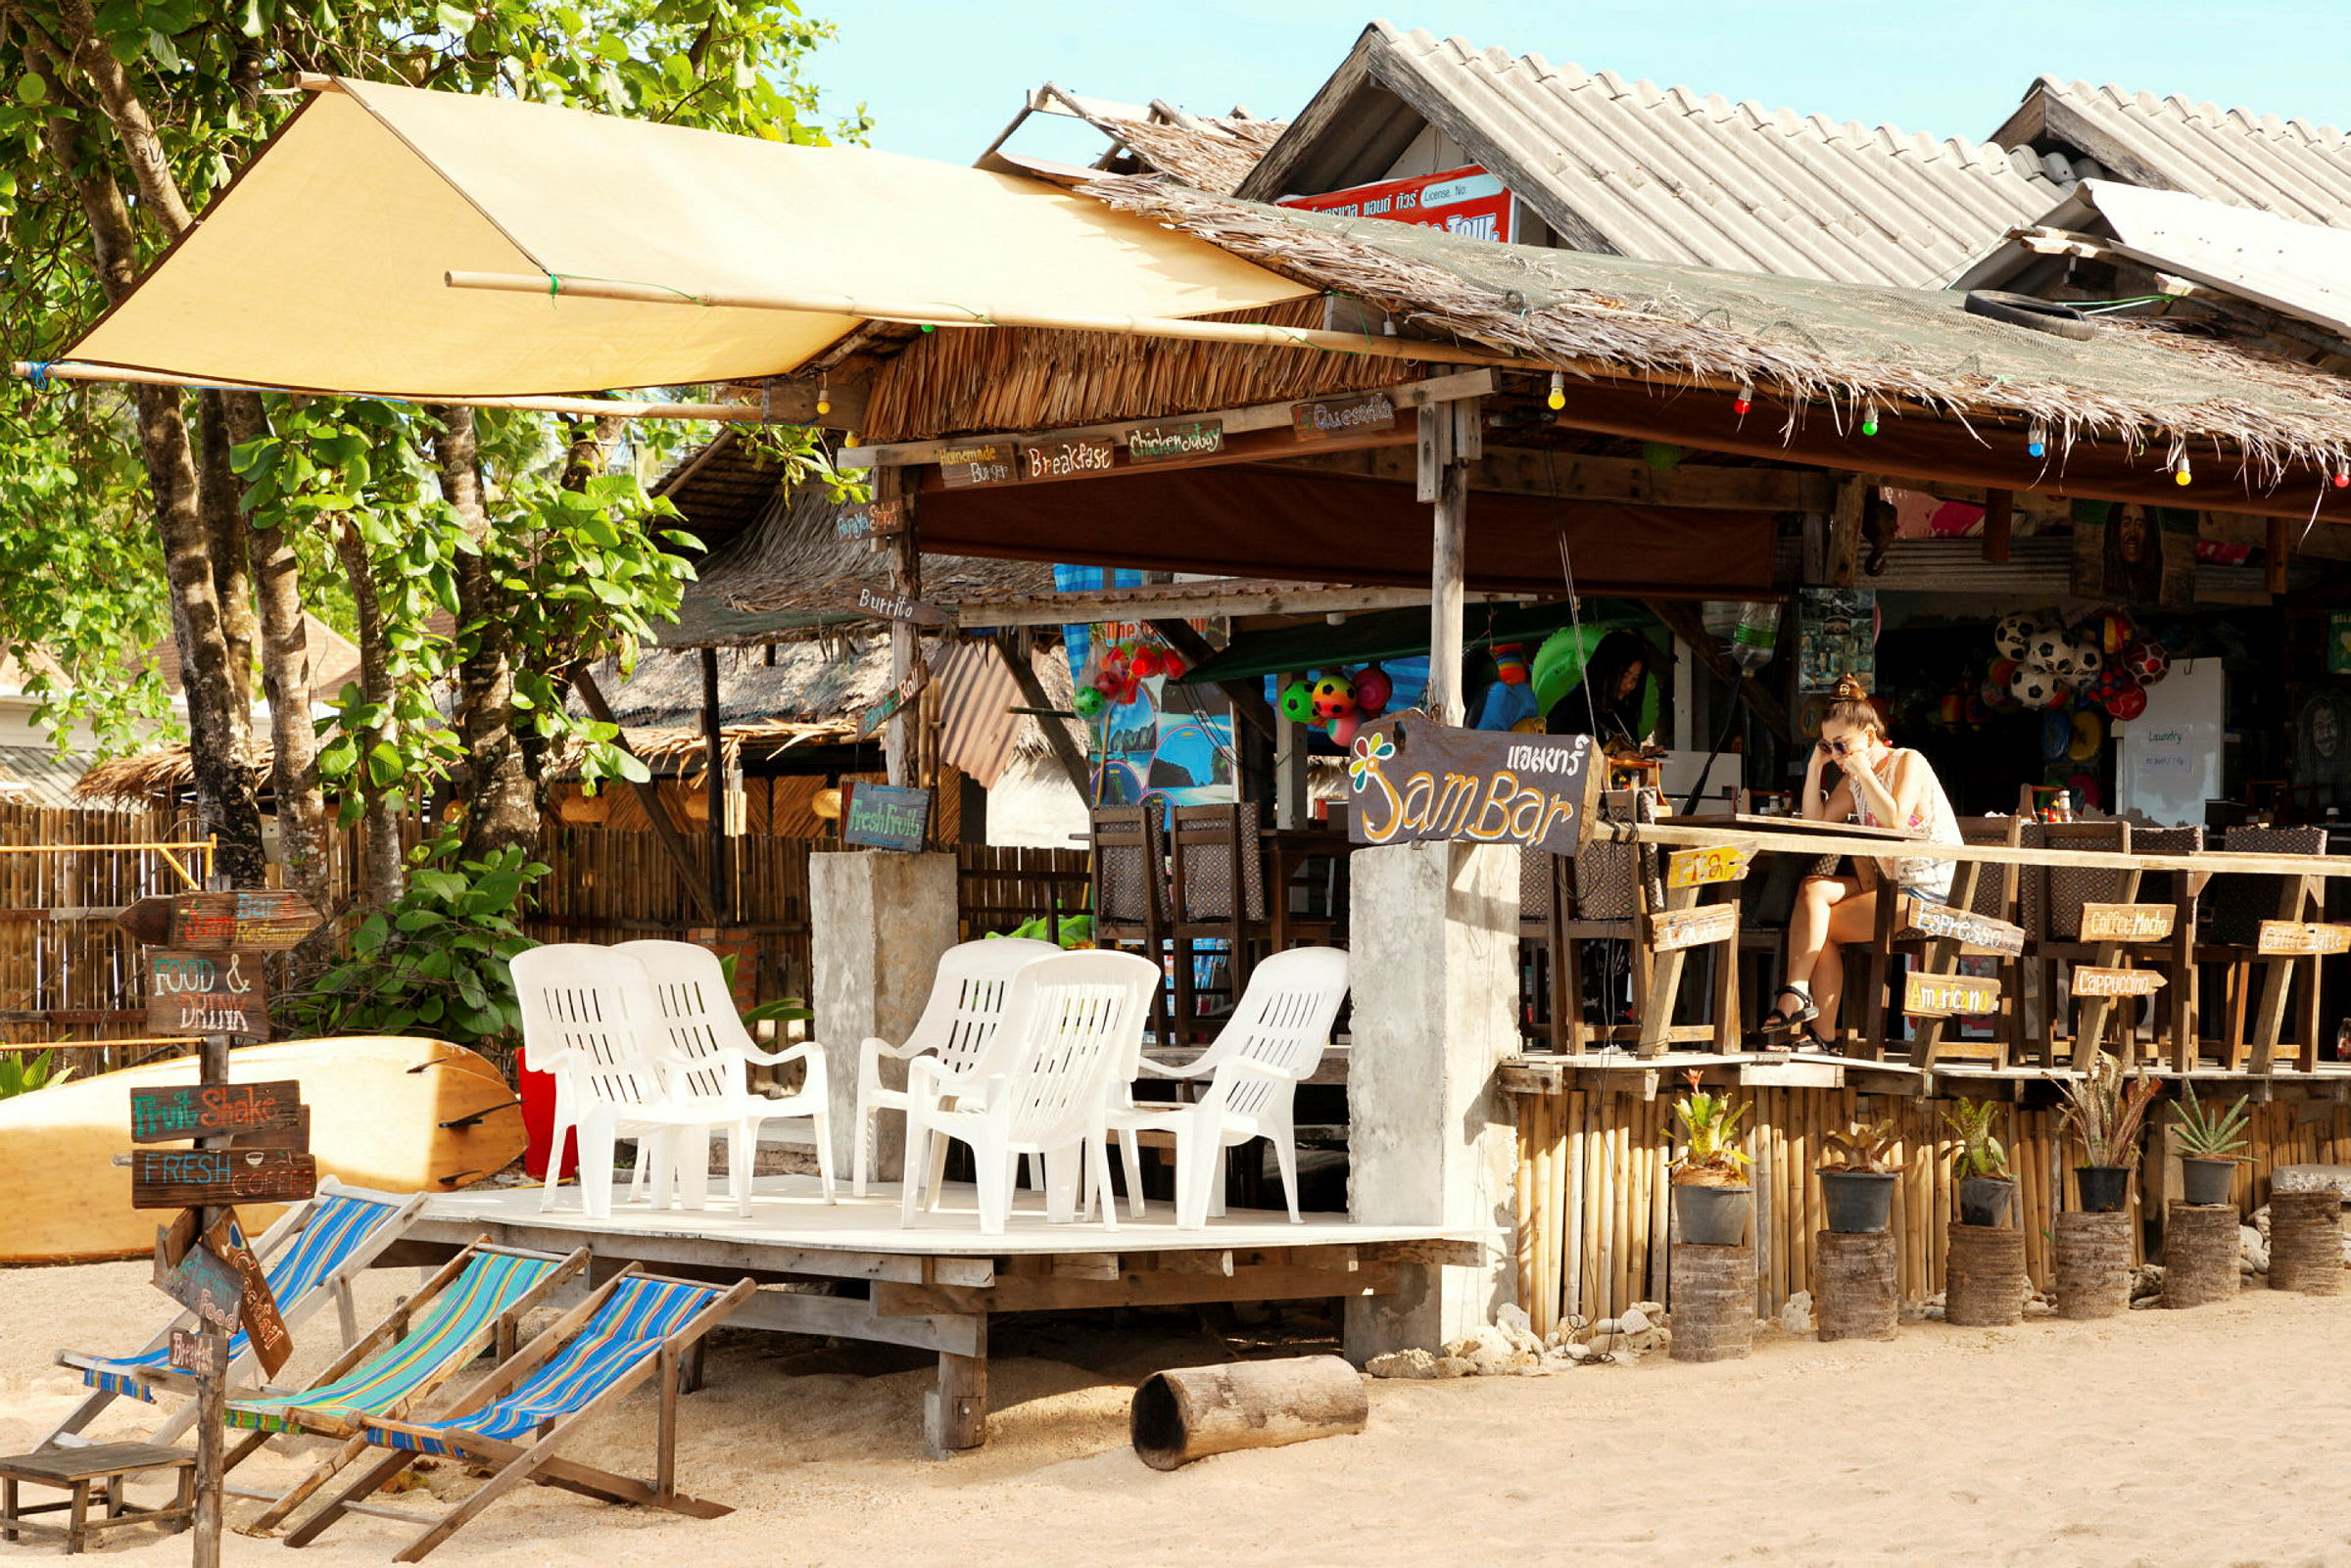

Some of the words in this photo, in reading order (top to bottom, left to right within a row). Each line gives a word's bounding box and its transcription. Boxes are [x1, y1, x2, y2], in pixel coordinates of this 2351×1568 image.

[1424, 189, 1451, 202] License
[1029, 443, 1111, 477] Breakfast
[859, 588, 913, 618] Burrito
[897, 667, 919, 706] Roll
[1360, 755, 1479, 843] Jam
[1465, 771, 1574, 847] Bar
[237, 893, 277, 919] Bar
[153, 958, 216, 997] FOOD
[225, 953, 252, 994] &
[2078, 969, 2151, 995] Cappuccino
[178, 992, 249, 1032] DRINK
[1909, 979, 1990, 1012] Americano
[131, 1089, 199, 1137] Fruit
[199, 1086, 277, 1127] Shake
[144, 1152, 231, 1185] FRESH
[198, 1287, 241, 1333] Food
